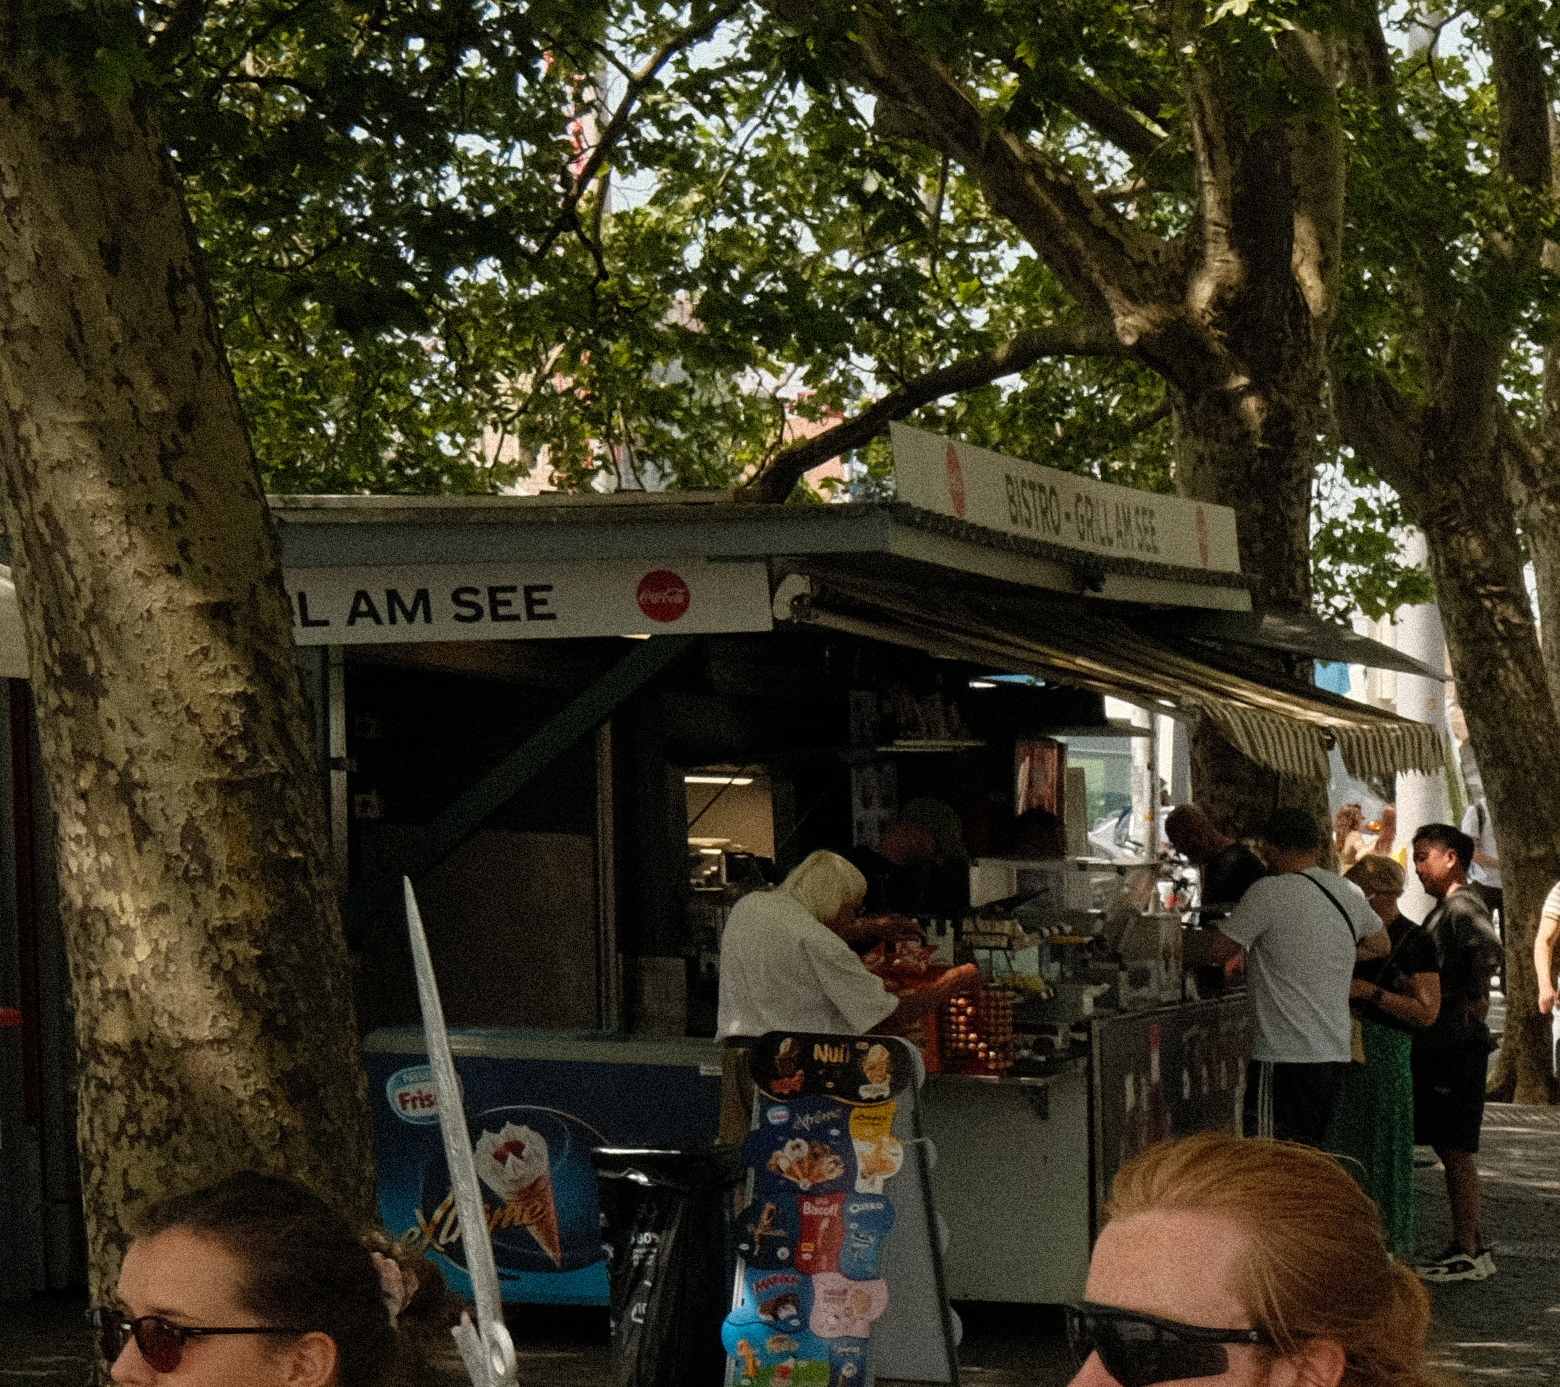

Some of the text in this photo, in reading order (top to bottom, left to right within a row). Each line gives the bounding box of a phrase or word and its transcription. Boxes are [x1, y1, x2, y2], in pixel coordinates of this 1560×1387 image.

[1004, 473, 1061, 536] BISTRO
[1135, 505, 1160, 554] SEE
[346, 588, 433, 627] AM
[450, 584, 558, 625] SEE
[398, 1089, 437, 1111] Fris
